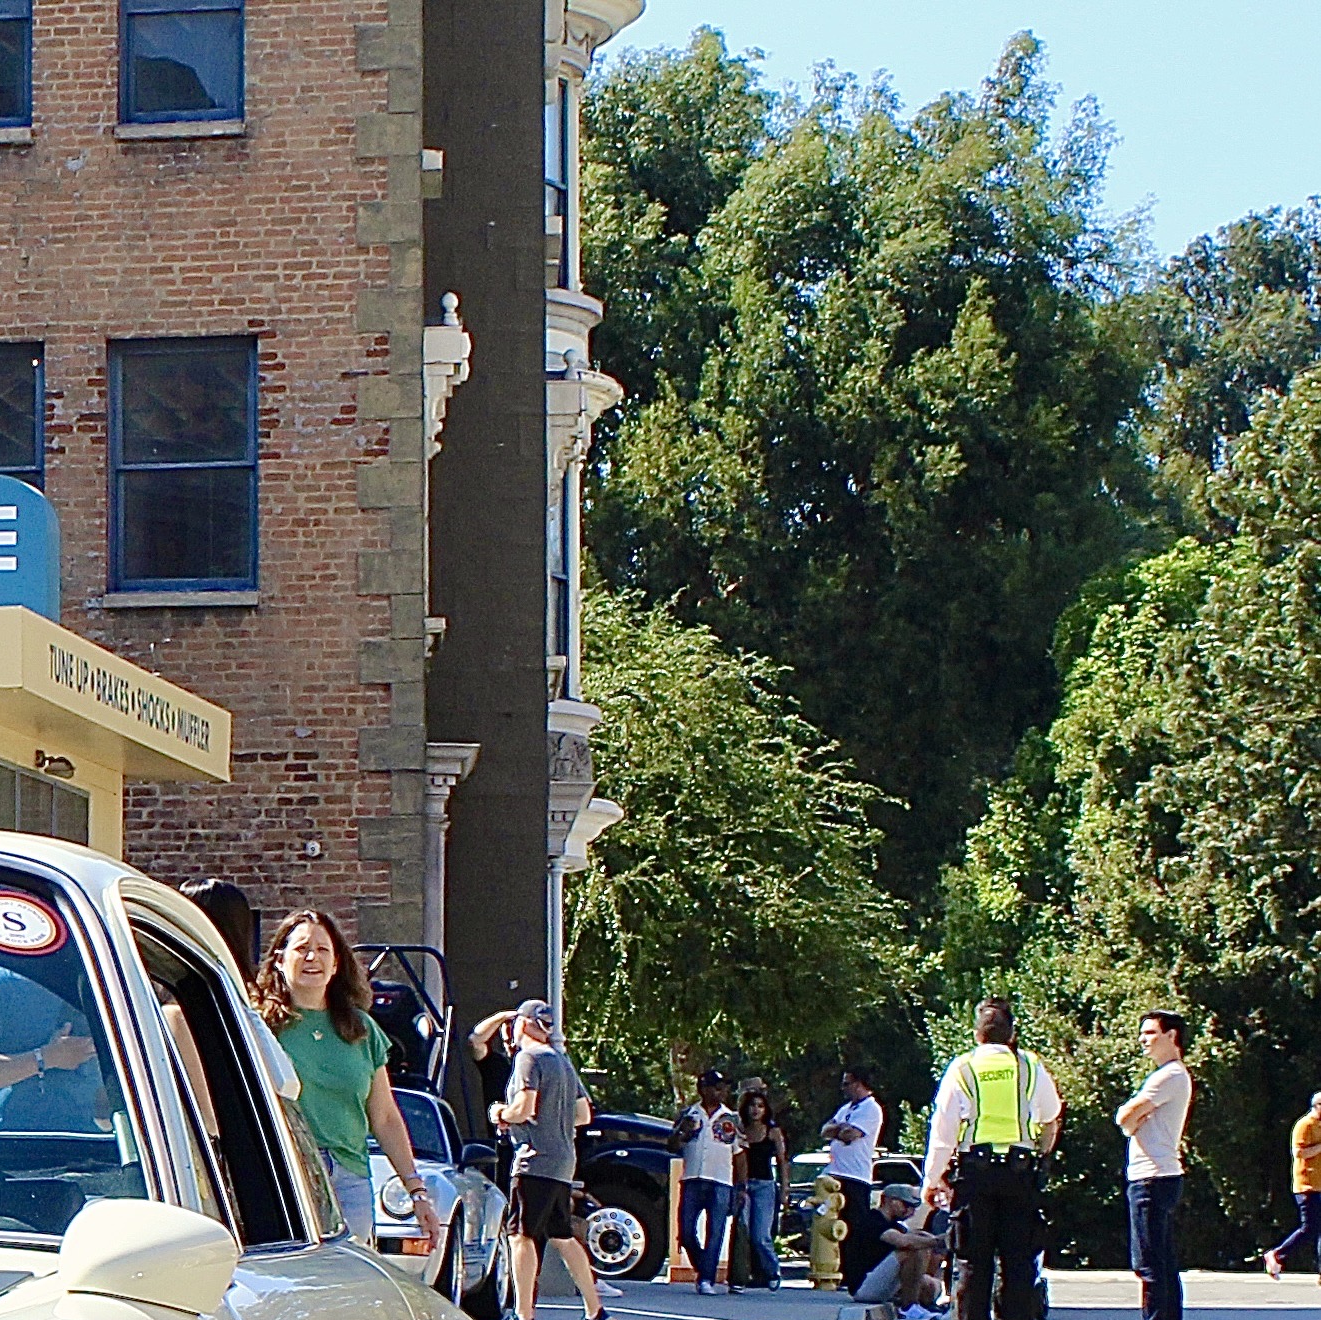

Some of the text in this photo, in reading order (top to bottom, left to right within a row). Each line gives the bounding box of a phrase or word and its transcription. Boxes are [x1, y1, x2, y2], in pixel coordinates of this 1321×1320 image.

[49, 644, 210, 753] TUNE UP BRAKES SHOCKS MUFFLER
[2, 911, 27, 932] S
[978, 1068, 1015, 1083] SECURITY
